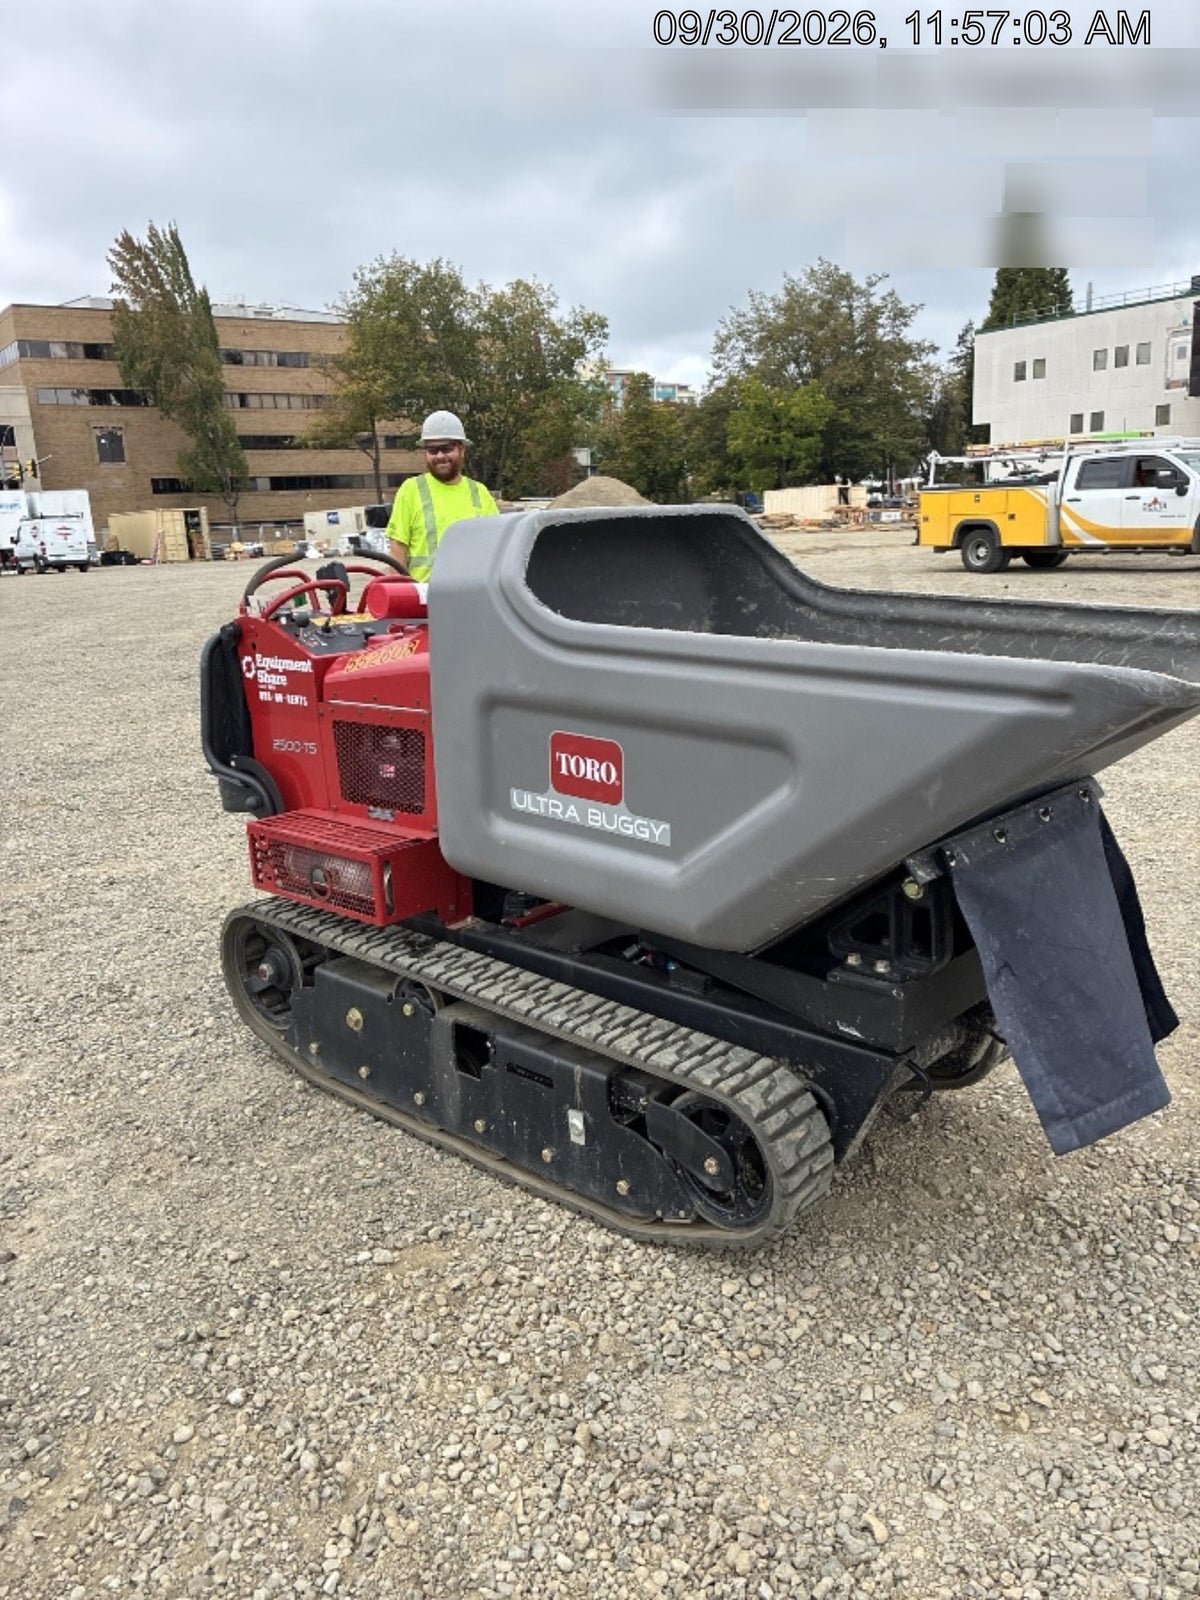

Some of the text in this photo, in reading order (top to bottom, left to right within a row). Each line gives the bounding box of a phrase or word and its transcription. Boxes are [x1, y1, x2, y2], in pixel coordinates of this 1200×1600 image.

[255, 653, 313, 672] Equipment
[257, 669, 288, 686] Share
[556, 752, 618, 786] TORO
[512, 790, 667, 842] ULTRA BUGGY
